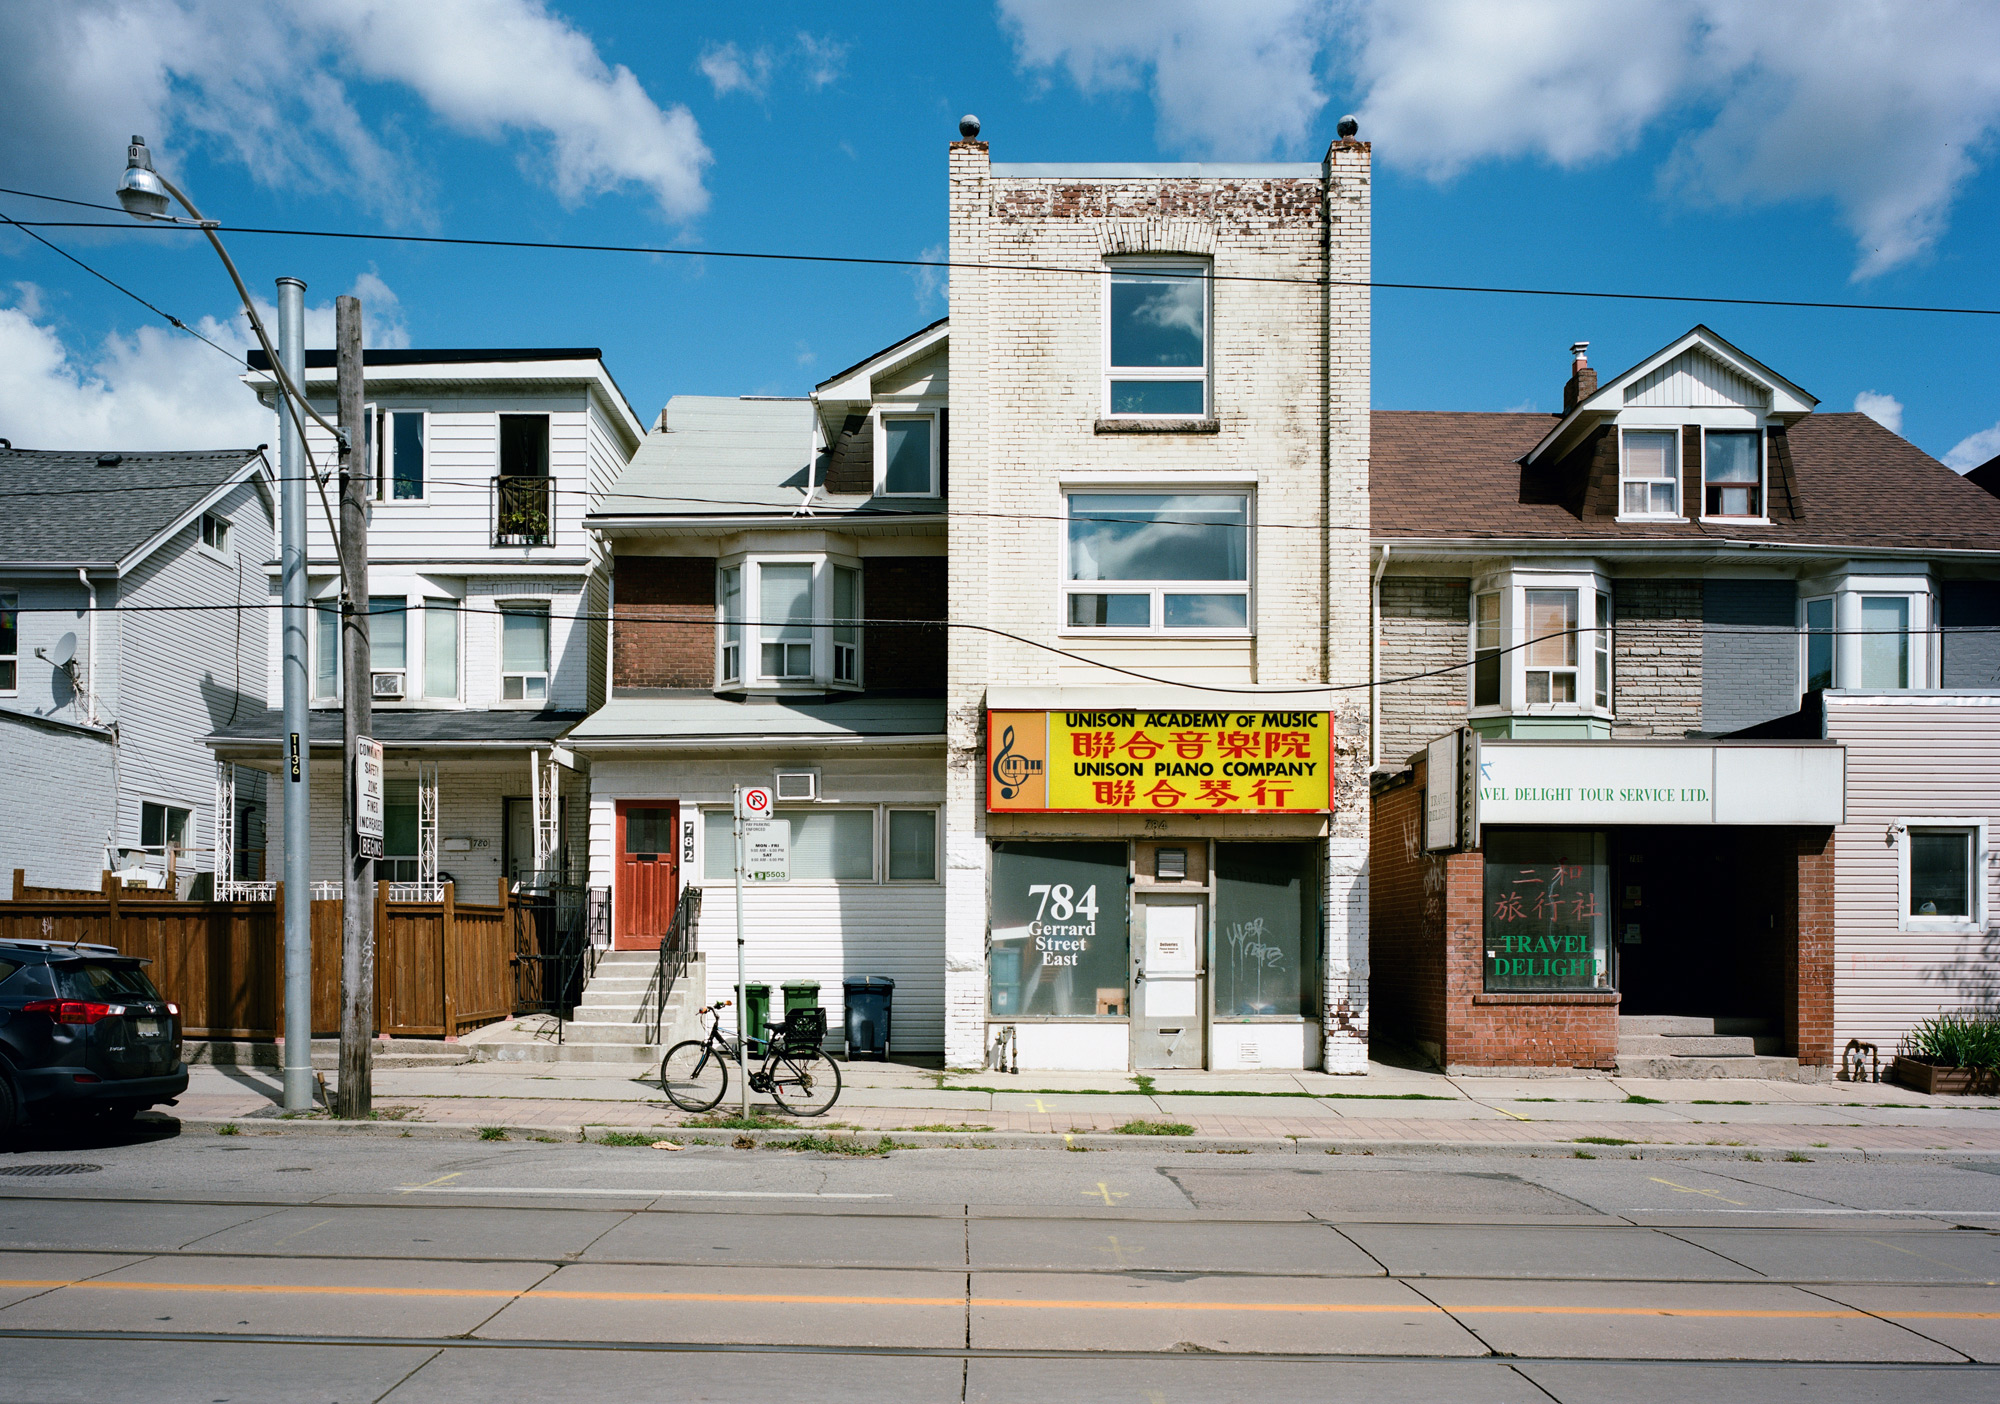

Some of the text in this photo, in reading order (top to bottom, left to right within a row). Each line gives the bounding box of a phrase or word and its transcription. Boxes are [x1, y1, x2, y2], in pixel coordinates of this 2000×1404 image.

[129, 147, 138, 157] 10
[1066, 713, 1318, 727] UNISON ACADEMY OF MUSIC
[291, 734, 300, 775] T136
[364, 761, 380, 778] SAFETY
[1074, 762, 1317, 776] UNISON PIANO COMPANY
[367, 780, 378, 795] ZONE
[1479, 787, 1709, 802] AVEL DELIGHT TOUR SERVICE LTD.
[366, 799, 379, 814] FINES
[359, 816, 383, 832] INCREASED
[362, 838, 382, 857] BEGINS
[684, 823, 693, 861] 782
[1028, 884, 1099, 920] 784
[1493, 891, 1603, 922] 旅行社
[1028, 921, 1096, 936] Gerrard
[1035, 936, 1087, 951] Street
[1501, 935, 1594, 953] TRAVEL
[1041, 951, 1078, 966] East
[1494, 958, 1602, 976] DELIGHT
